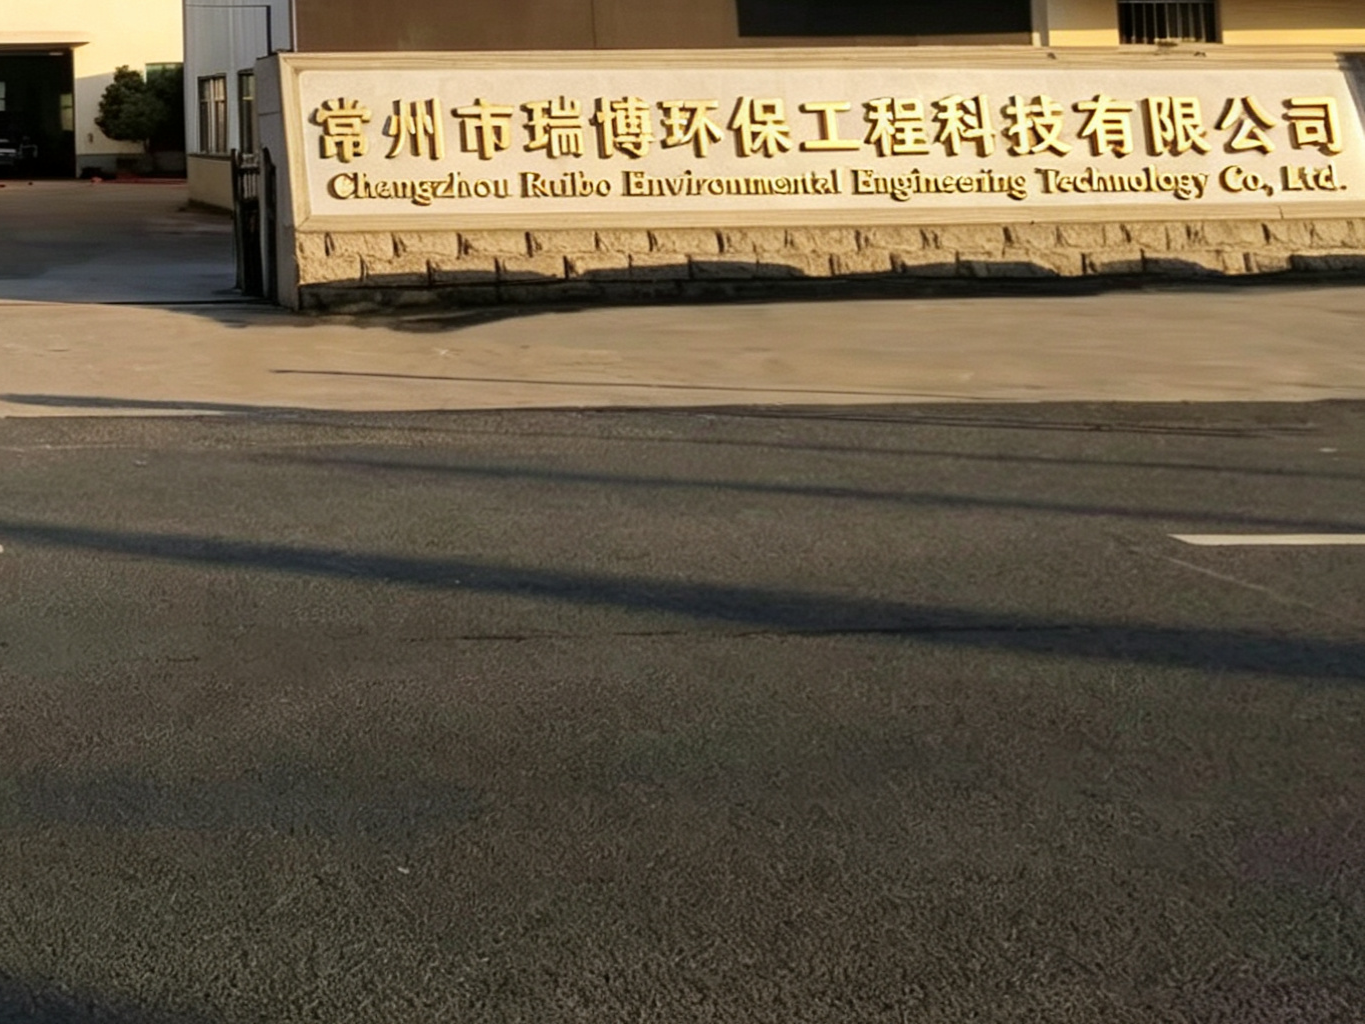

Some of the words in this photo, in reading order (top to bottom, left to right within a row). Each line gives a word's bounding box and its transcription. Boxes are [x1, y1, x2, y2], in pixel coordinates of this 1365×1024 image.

[313, 93, 1343, 163] 常州市瑞博环保工程科技有限公司
[519, 170, 611, 198] Ruibo
[621, 169, 842, 197] Environmental
[851, 167, 1028, 202] Engineering
[1035, 163, 1209, 200] Technology
[1280, 160, 1347, 192] Ltd.
